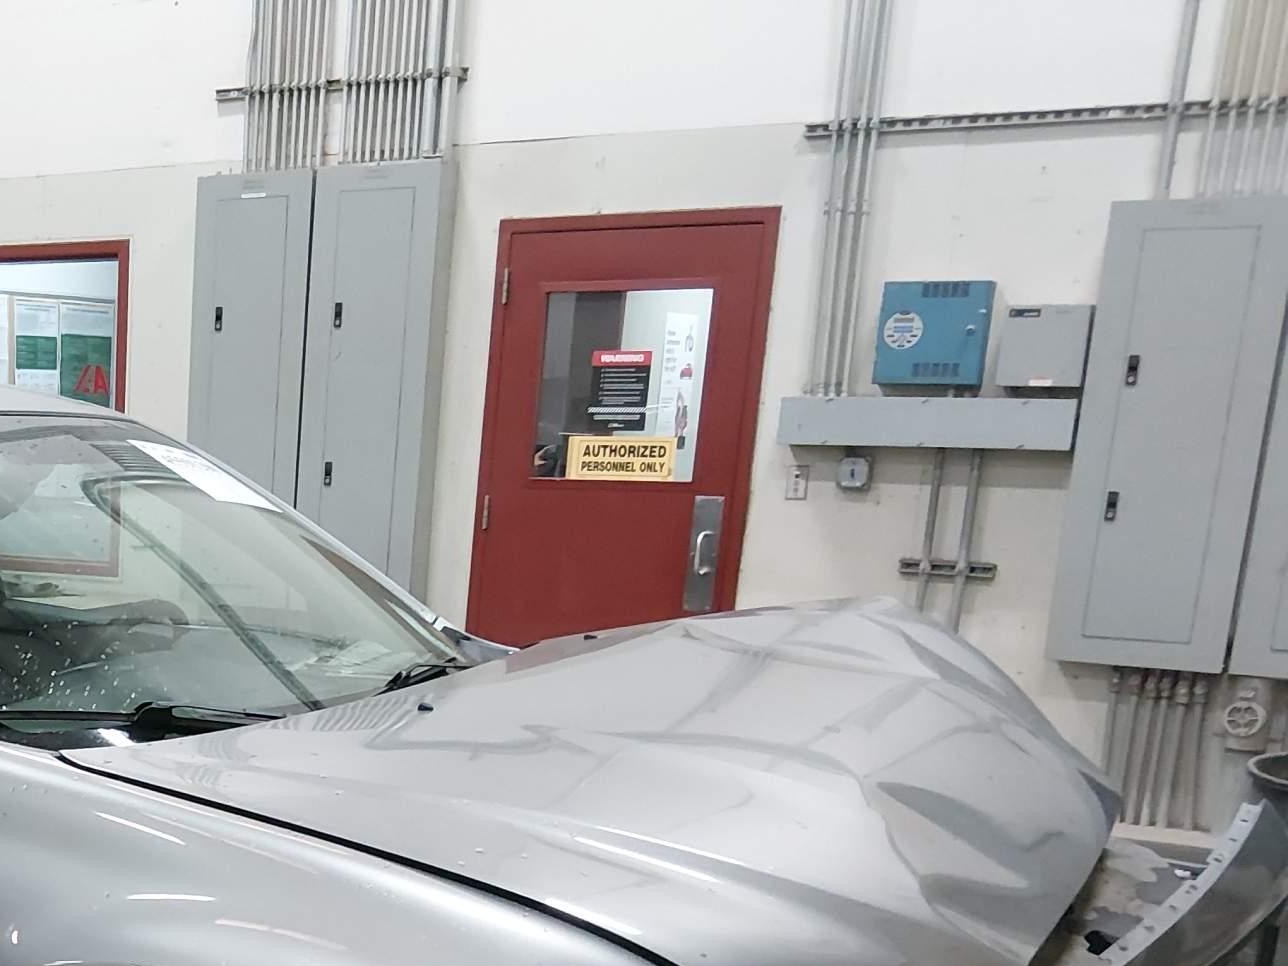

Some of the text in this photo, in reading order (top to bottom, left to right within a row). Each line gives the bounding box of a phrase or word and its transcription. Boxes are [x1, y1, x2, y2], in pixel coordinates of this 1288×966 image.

[583, 444, 666, 458] AUTHORIZED
[581, 461, 665, 472] PERSONNEL ONLY
